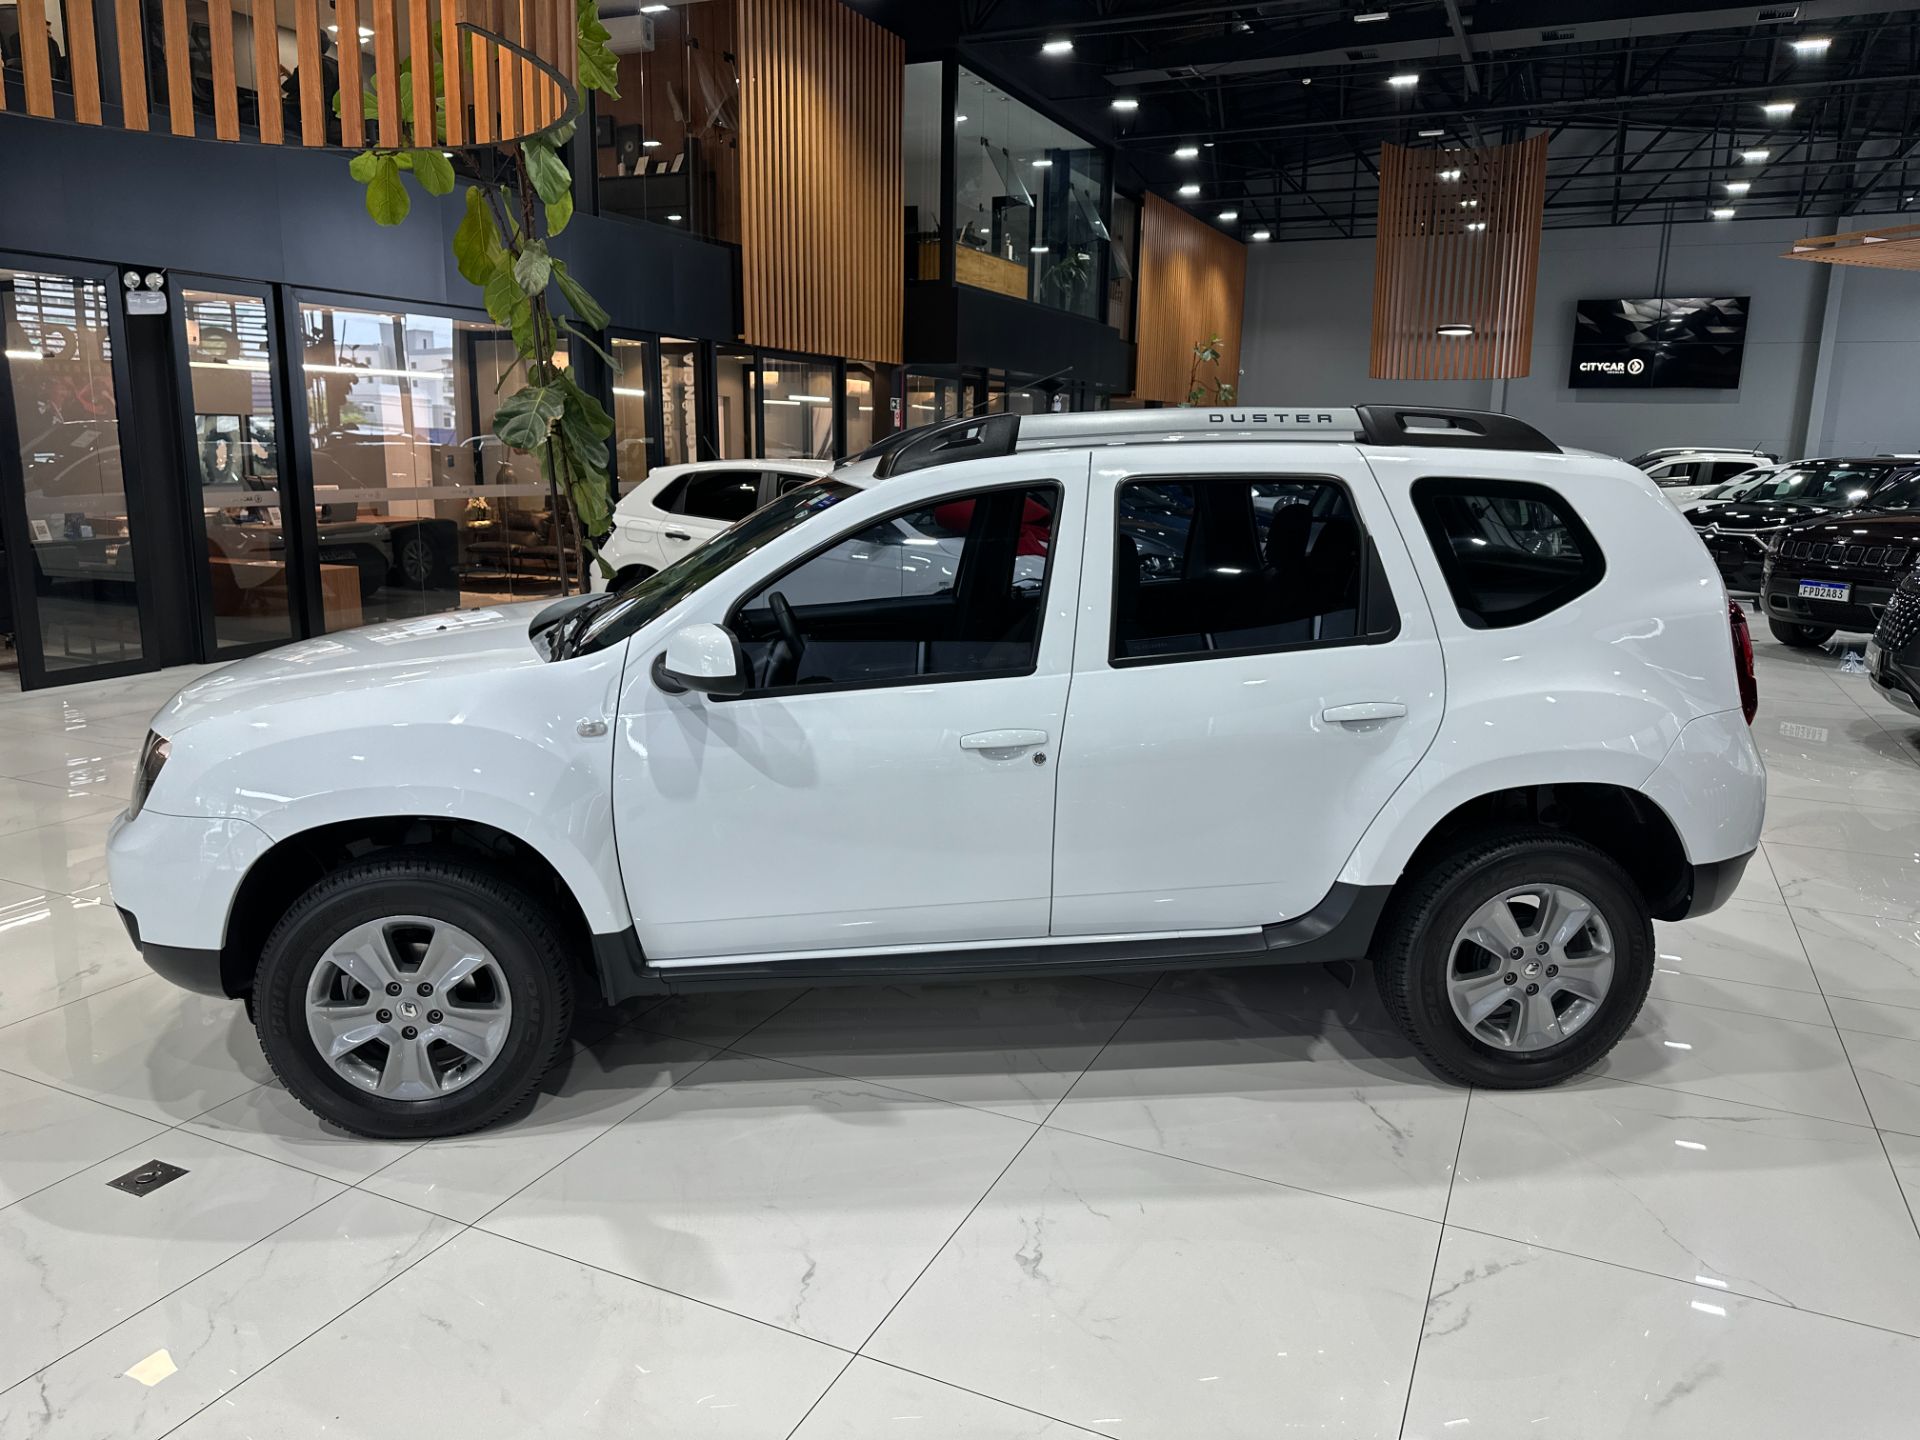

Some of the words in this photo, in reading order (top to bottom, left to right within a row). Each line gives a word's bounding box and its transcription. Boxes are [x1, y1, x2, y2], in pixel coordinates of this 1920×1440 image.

[1579, 362, 1625, 371] CITYCAR
[1209, 413, 1333, 424] DUSTER
[1802, 586, 1844, 599] FPD2A83
